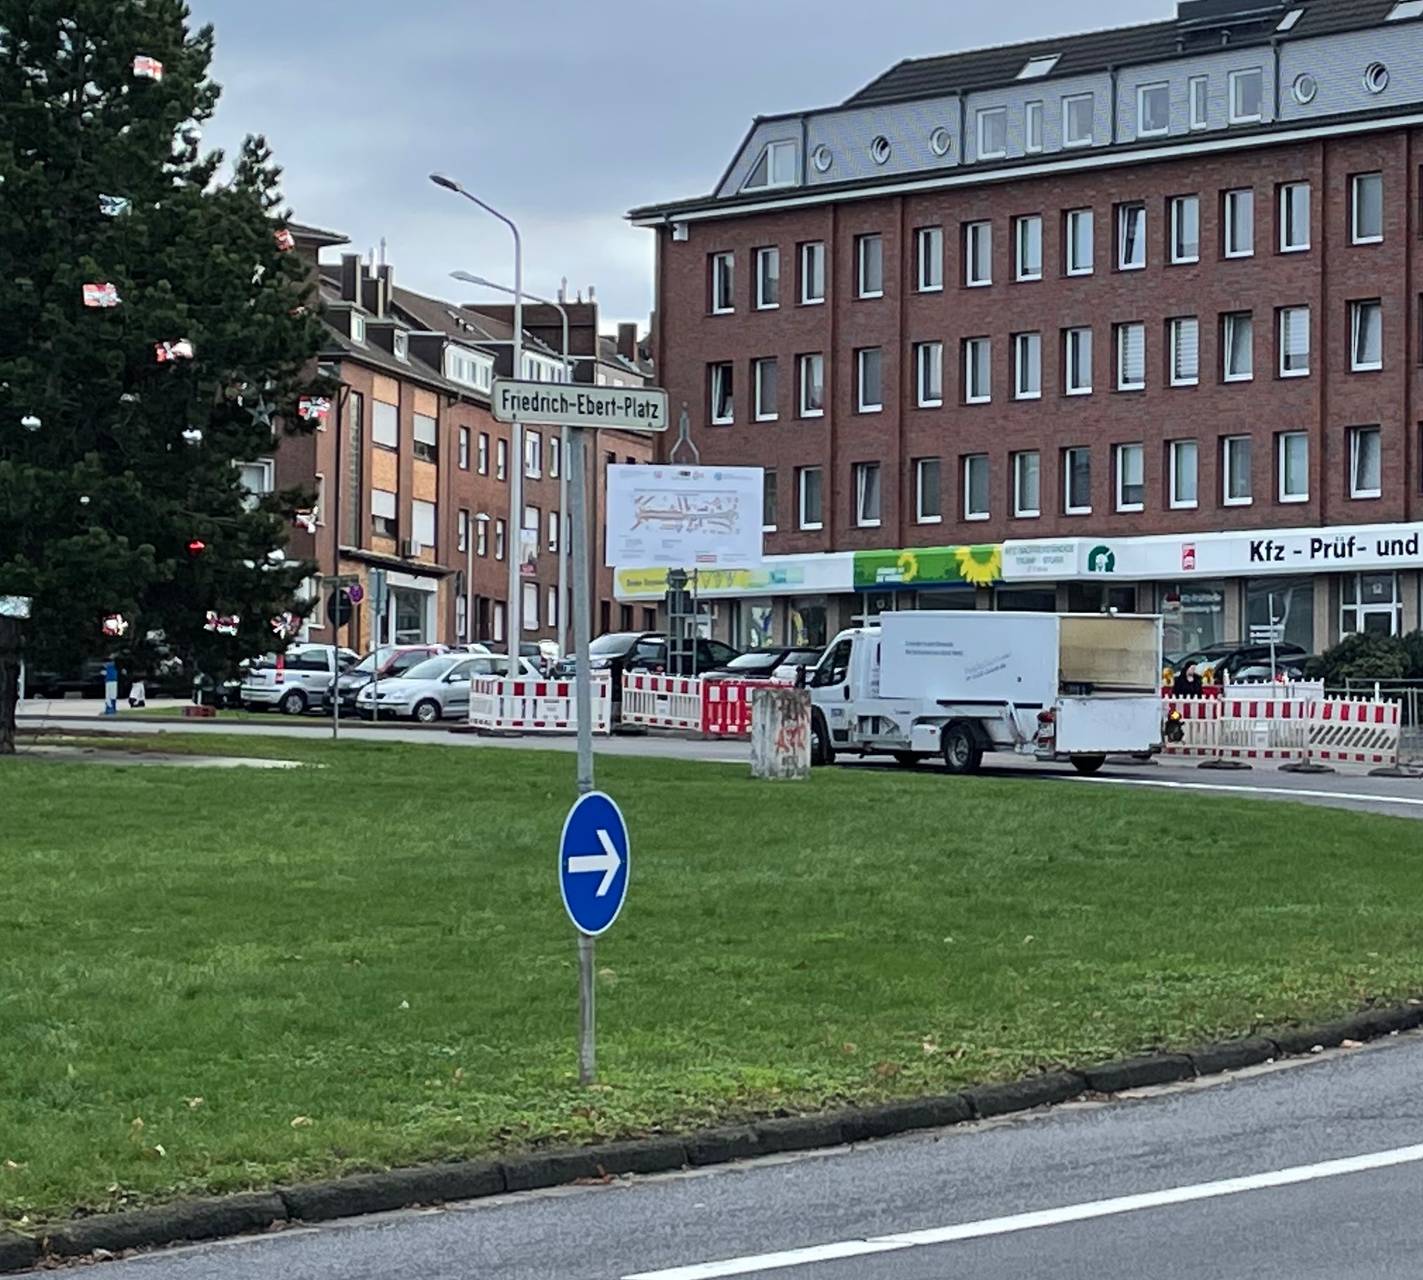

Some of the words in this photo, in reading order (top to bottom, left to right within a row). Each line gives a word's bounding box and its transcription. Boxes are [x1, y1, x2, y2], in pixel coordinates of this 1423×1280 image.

[502, 388, 659, 419] Friedrich-Ebert-Platz
[1250, 540, 1285, 562] Kfz
[1310, 536, 1367, 559] Prüf-
[1376, 532, 1419, 556] und
